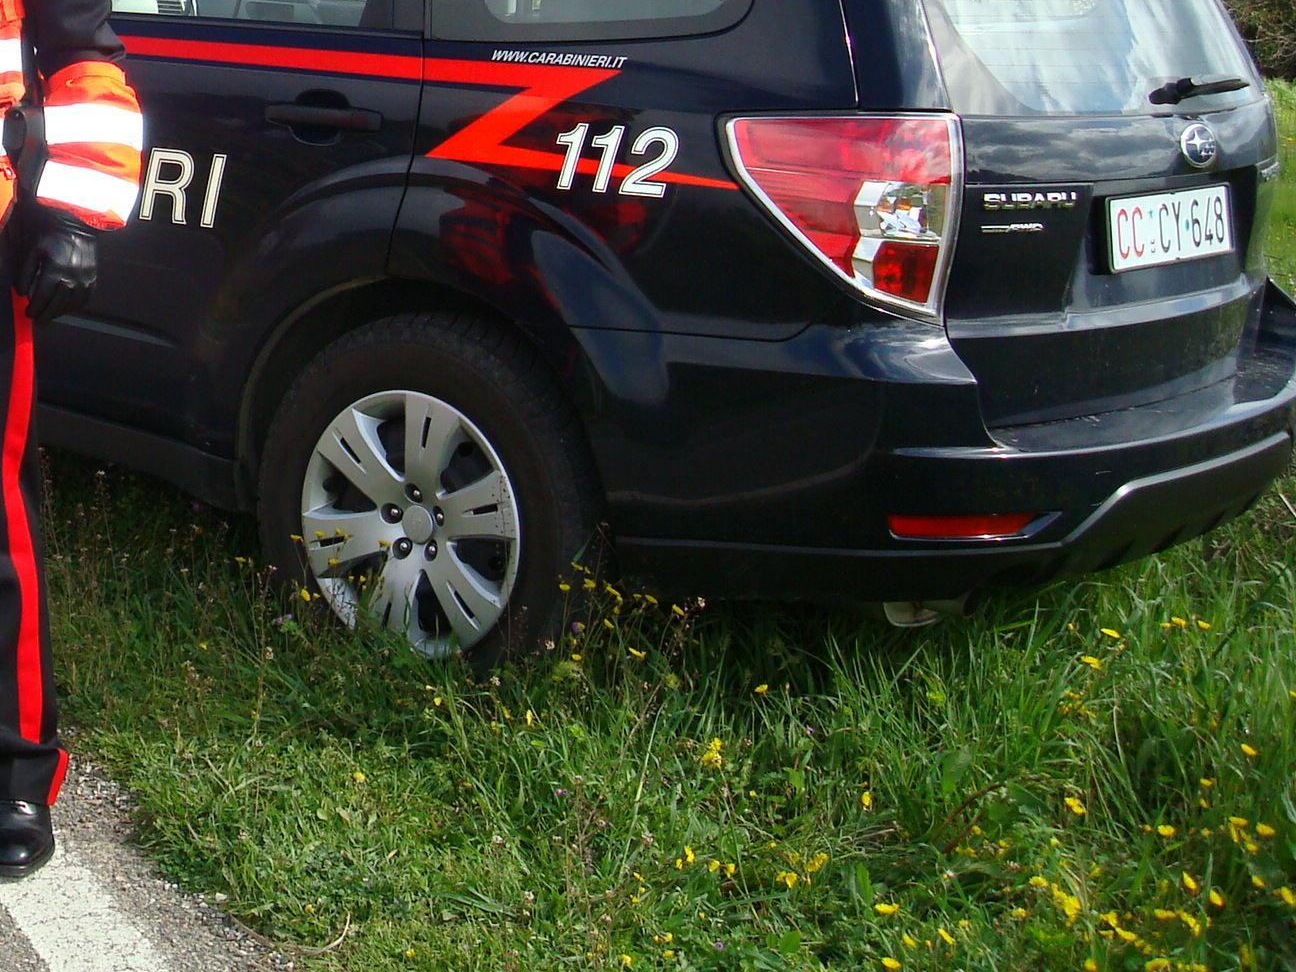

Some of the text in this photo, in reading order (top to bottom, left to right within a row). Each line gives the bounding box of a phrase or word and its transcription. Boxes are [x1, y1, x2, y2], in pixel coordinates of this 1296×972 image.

[491, 49, 628, 69] WWW.CARABINIERI.IT
[556, 122, 680, 199] 112
[138, 147, 228, 228] RI
[983, 192, 1077, 210] SUBARU
